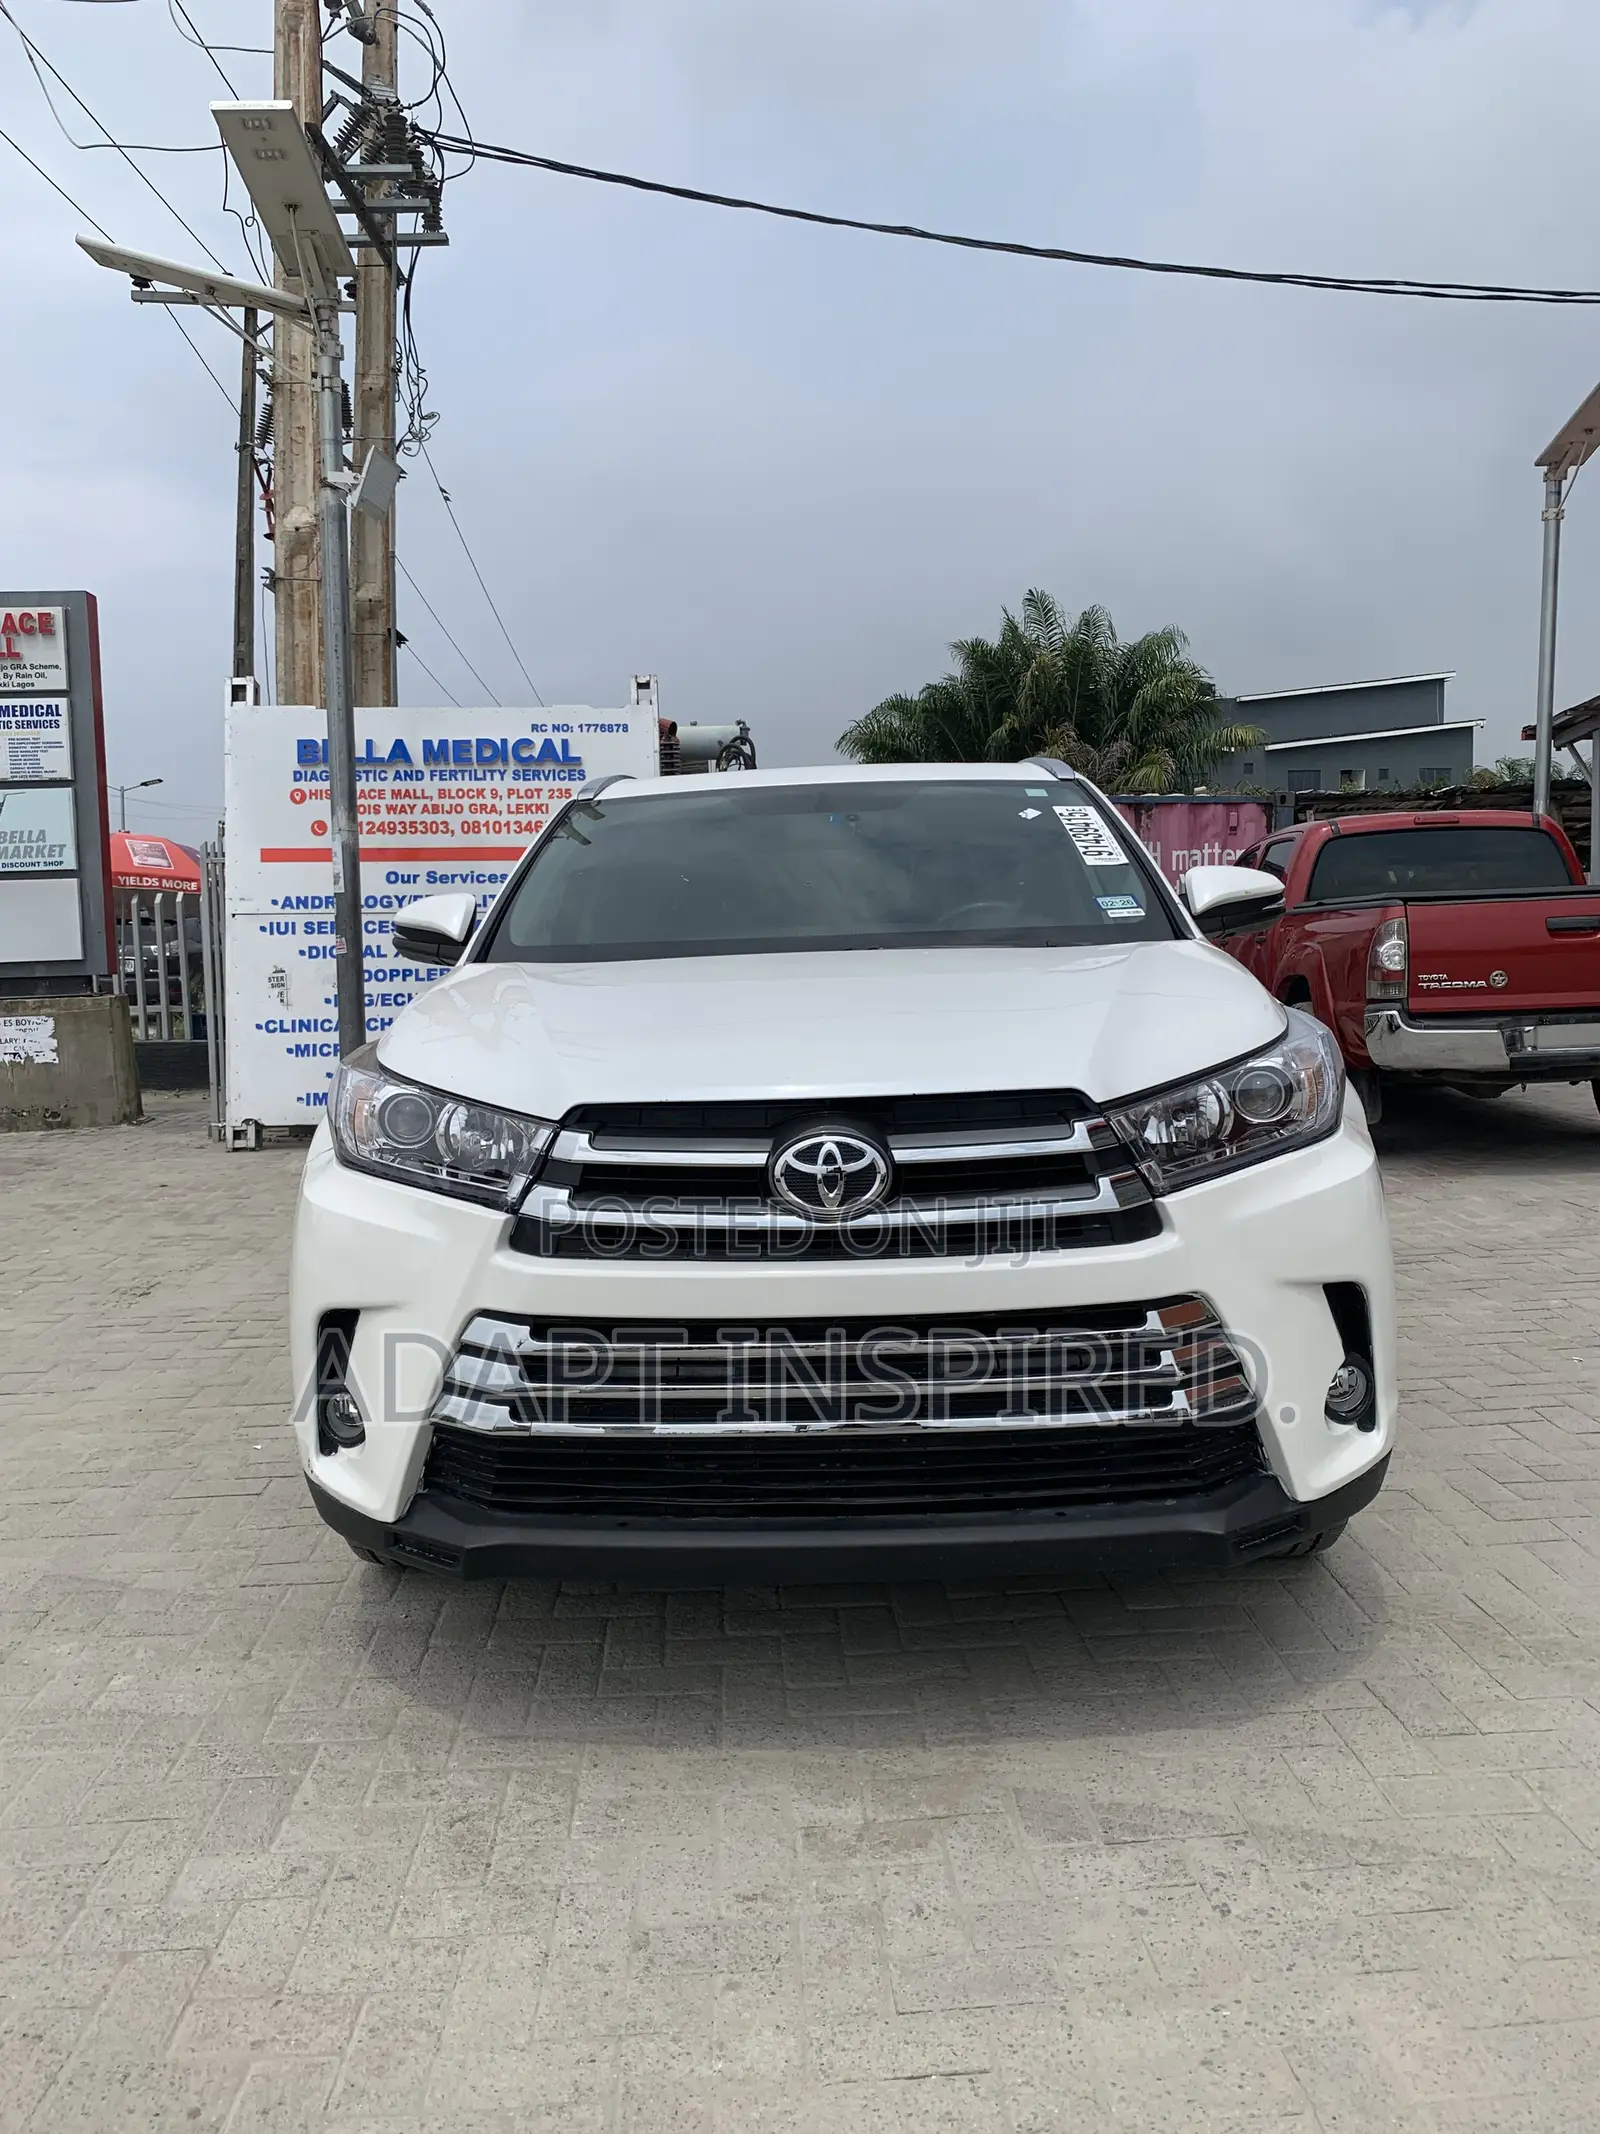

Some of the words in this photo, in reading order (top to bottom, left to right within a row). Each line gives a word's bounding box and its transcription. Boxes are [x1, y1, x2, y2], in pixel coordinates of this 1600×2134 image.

[0, 612, 53, 634] ACE
[0, 637, 21, 658] L
[29, 663, 62, 671] Scheme,
[3, 672, 14, 680] By
[34, 672, 48, 680] Oil,
[11, 681, 35, 689] Lagos
[0, 704, 62, 718] MEDICAL
[0, 719, 13, 730] TIC
[15, 719, 60, 730] SERVICES
[531, 723, 548, 733] RC
[552, 723, 574, 733] NO:
[577, 723, 629, 733] 1776878
[297, 738, 413, 765] BLA
[422, 738, 582, 765] MEDICAL
[293, 769, 388, 782] DIAGSTIC
[393, 769, 425, 782] AND
[430, 769, 508, 782] FERTILITY
[512, 768, 586, 782] SERVICES
[309, 788, 332, 800] HIS
[357, 788, 386, 800] ACE
[391, 788, 434, 802] MALL,
[438, 788, 486, 800] BLOCK
[490, 788, 503, 801] 9,
[507, 788, 544, 800] PLOT
[548, 788, 573, 800] 235
[357, 803, 382, 815] OIS
[385, 803, 418, 815] WAY
[421, 803, 464, 815] ABIJO
[468, 803, 503, 816] GRA,
[507, 803, 549, 815] LEKKI
[356, 820, 455, 837] 124935303,
[461, 820, 547, 835] 08101346
[0, 829, 47, 845] BELLA
[0, 844, 67, 860] MARKET
[1, 861, 41, 869] DISCOUNT
[118, 875, 160, 887] YIELDS
[161, 879, 198, 891] MORE
[385, 871, 420, 885] Our
[1418, 980, 1488, 990] TACOMA
[365, 1017, 394, 1032] CH
[305, 1092, 329, 1107] IM
